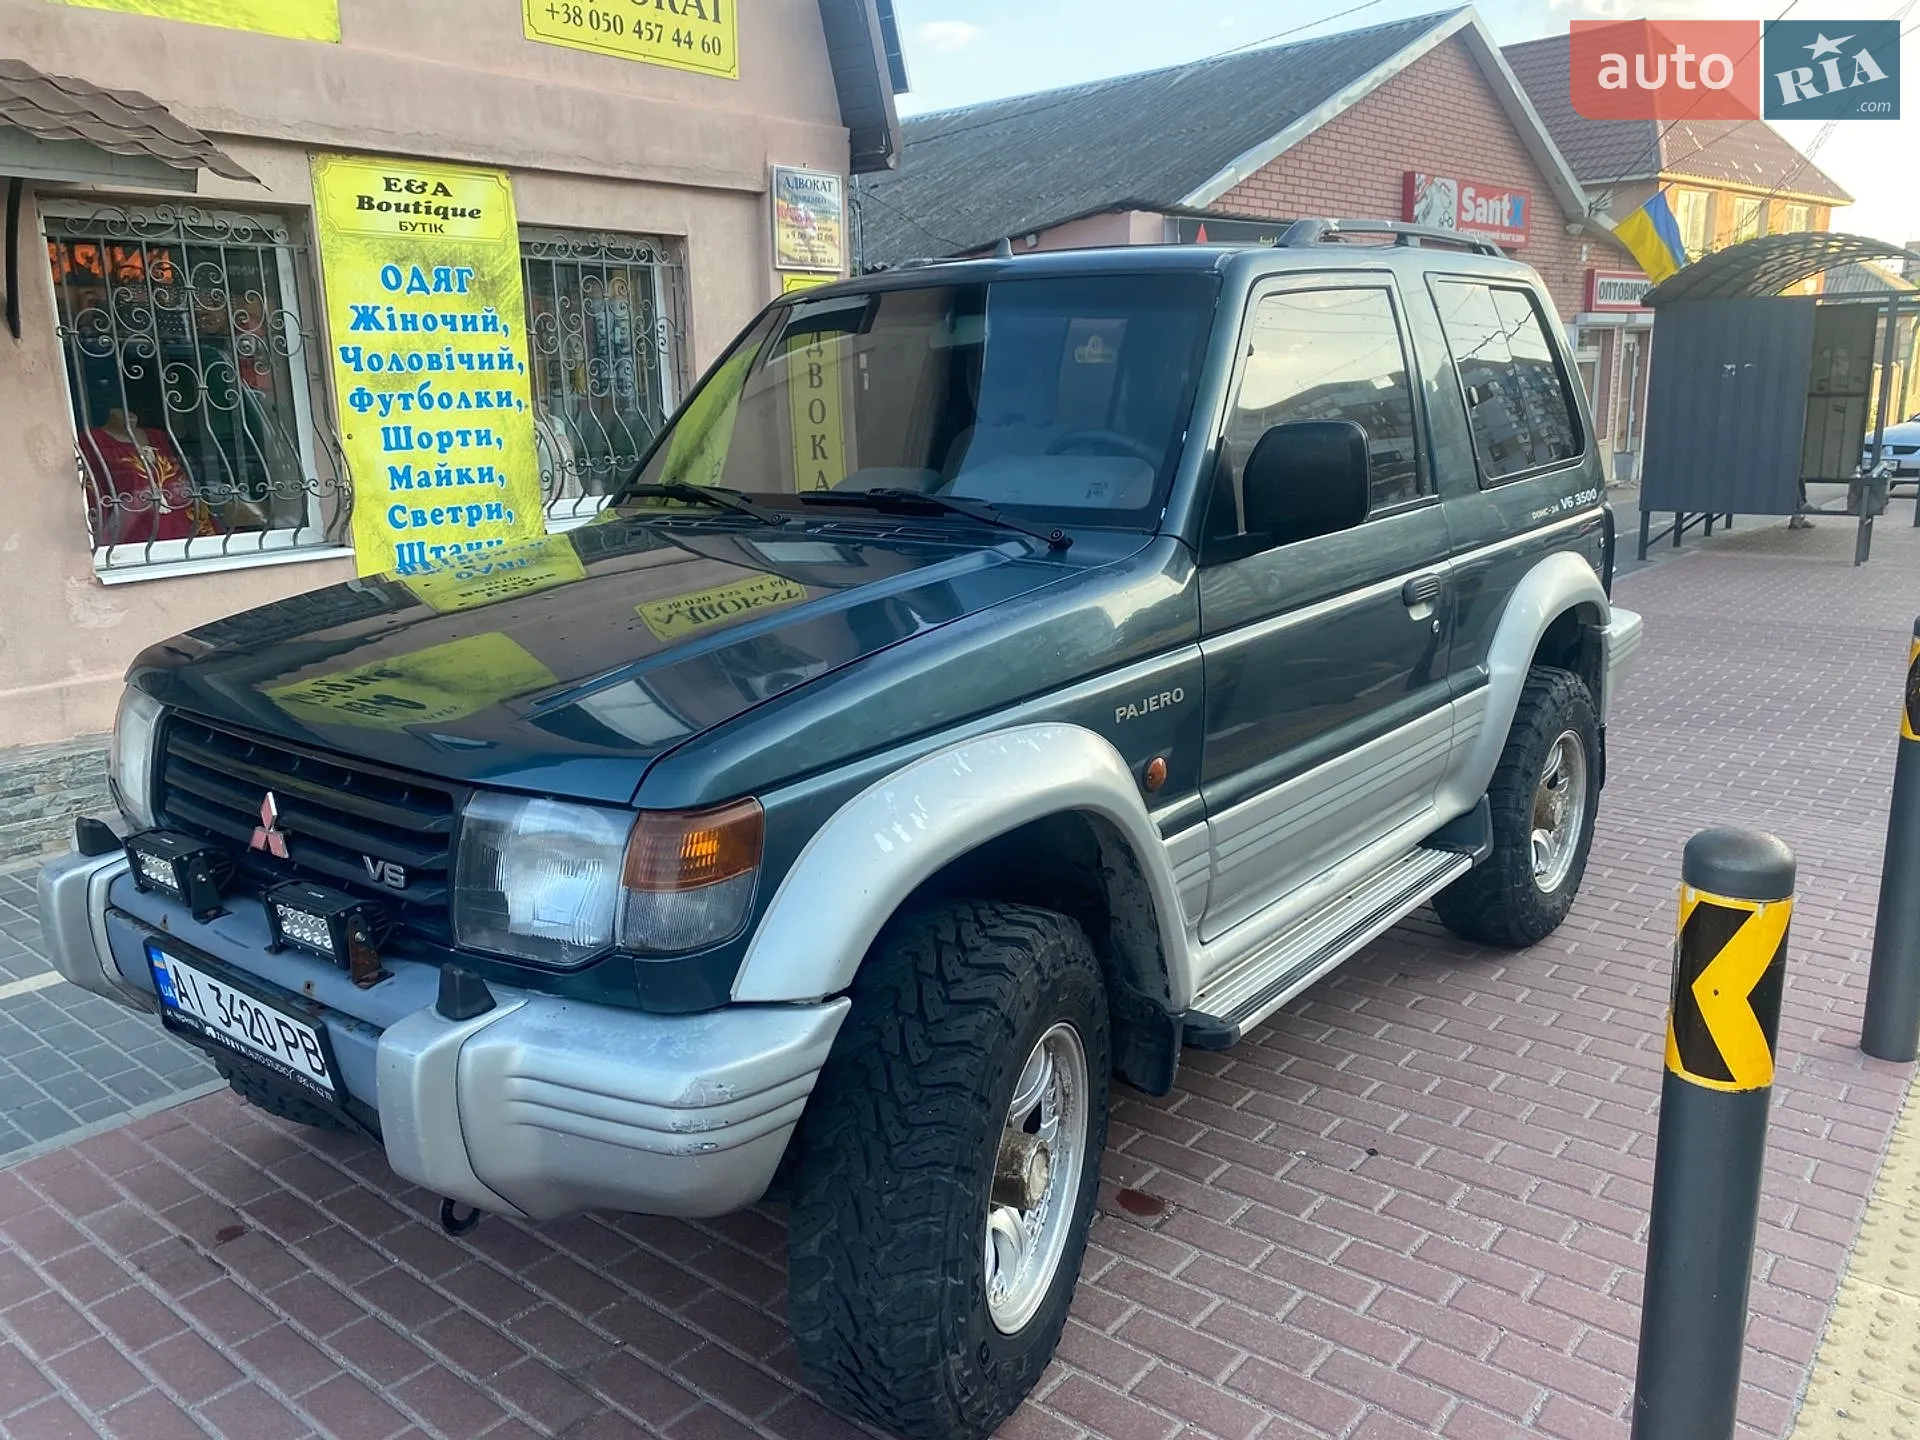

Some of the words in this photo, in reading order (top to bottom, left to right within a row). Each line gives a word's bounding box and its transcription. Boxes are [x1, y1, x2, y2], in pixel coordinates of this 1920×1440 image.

[545, 3, 583, 27] +38
[589, 9, 624, 35] 050
[632, 19, 663, 43] 457
[672, 28, 693, 50] 44
[701, 34, 721, 56] 60
[785, 176, 833, 192] АДВОКАТ
[356, 195, 482, 220] Boutique
[398, 220, 445, 234] БУТІК
[380, 264, 474, 295] ОДЯГ
[1598, 281, 1653, 300] ОПТОВИЧО
[349, 305, 510, 338] Жіночий,
[340, 346, 525, 376] Чоловічий,
[349, 380, 524, 418] Футболки,
[806, 332, 829, 490] ДВОКА
[381, 425, 504, 453] Шорти,
[388, 462, 506, 491] Майки,
[1560, 495, 1575, 510] V6
[1575, 488, 1597, 506] 3500
[387, 502, 515, 530] Светри,
[1114, 687, 1185, 724] PAJERO
[362, 854, 407, 889] V6
[161, 984, 175, 1000] UA
[172, 964, 207, 1017] AI
[208, 982, 277, 1052] 3420
[274, 1017, 327, 1078] PB
